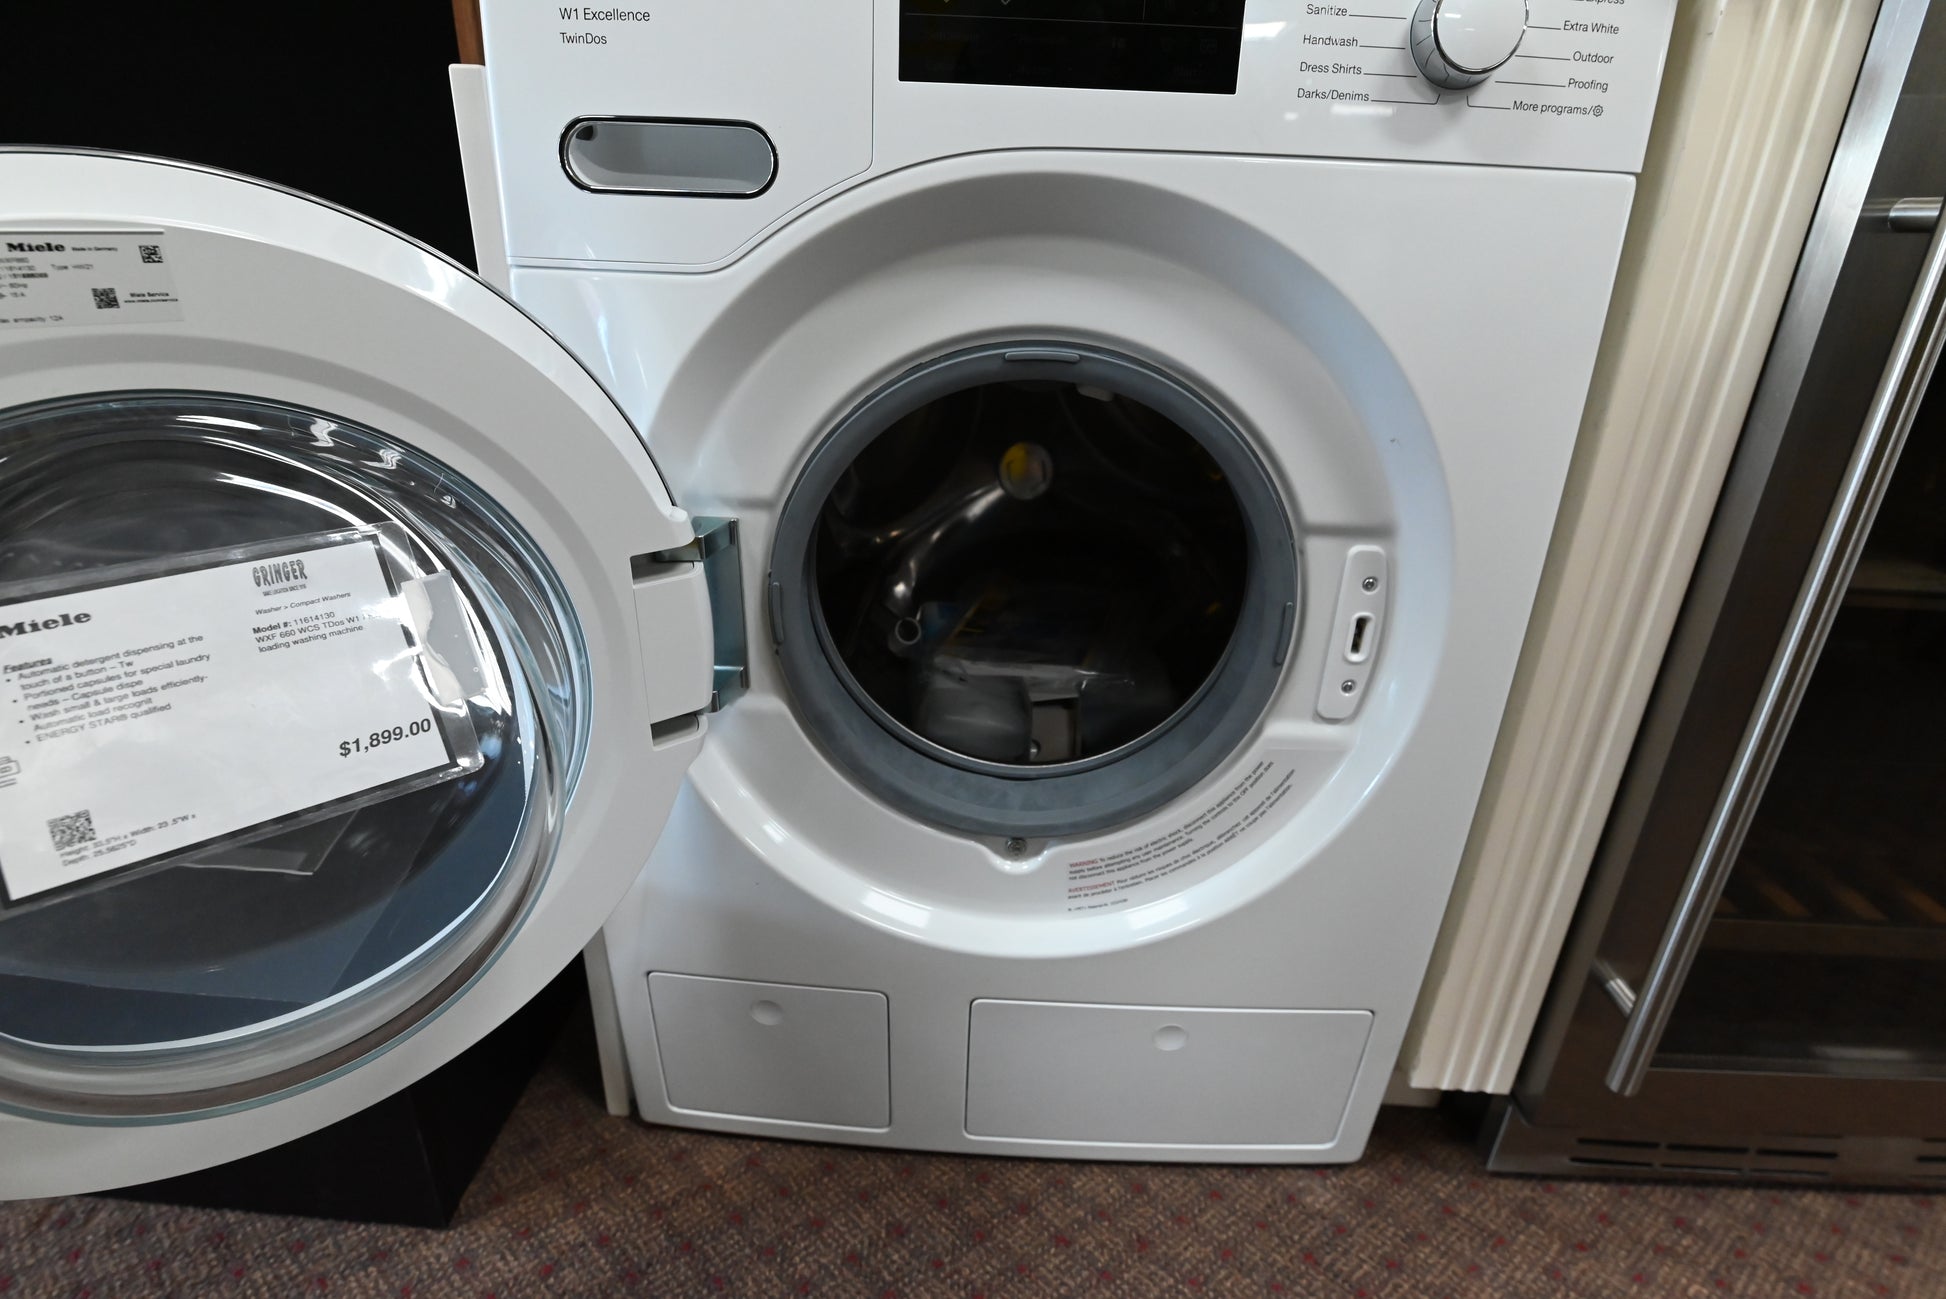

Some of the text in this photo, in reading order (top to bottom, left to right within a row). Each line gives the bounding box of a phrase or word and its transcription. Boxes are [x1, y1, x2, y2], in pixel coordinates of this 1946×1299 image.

[559, 7, 651, 21] W1 Excellence
[1306, 3, 1348, 17] Sanitize
[1563, 20, 1620, 35] Extra White
[559, 32, 608, 45] TwinDos
[1302, 34, 1359, 47] Handwash
[1572, 50, 1615, 64] Outdoor
[1299, 61, 1362, 75] Dress Shirts
[1567, 77, 1609, 93] Proofing
[1297, 87, 1370, 101] Darks/Denims
[1512, 100, 1539, 112] More
[6, 242, 66, 252] Miele
[252, 559, 308, 587] GRINGER
[255, 605, 282, 615] Washer
[289, 598, 321, 609] Compact
[321, 591, 352, 603] Washers
[0, 613, 91, 639] Miele
[252, 611, 336, 635] Model #: 11614130
[255, 633, 278, 644] WXF
[279, 629, 296, 639] 660
[298, 623, 321, 635] WCS
[323, 620, 345, 630] TDos
[258, 625, 364, 653] loading washing machine
[72, 652, 121, 668] detergent
[122, 642, 175, 658] dispensing
[177, 638, 187, 646] at
[188, 635, 204, 643] the
[52, 675, 62, 683] of
[74, 666, 107, 678] button
[76, 674, 122, 689] capsules
[124, 670, 137, 678] for
[140, 661, 174, 675] special
[175, 654, 211, 667] laundry
[71, 686, 114, 701] Capsule
[116, 679, 144, 691] dispe
[131, 686, 159, 698] loads
[130, 703, 172, 719] qualified
[339, 718, 432, 758] $1,899.00
